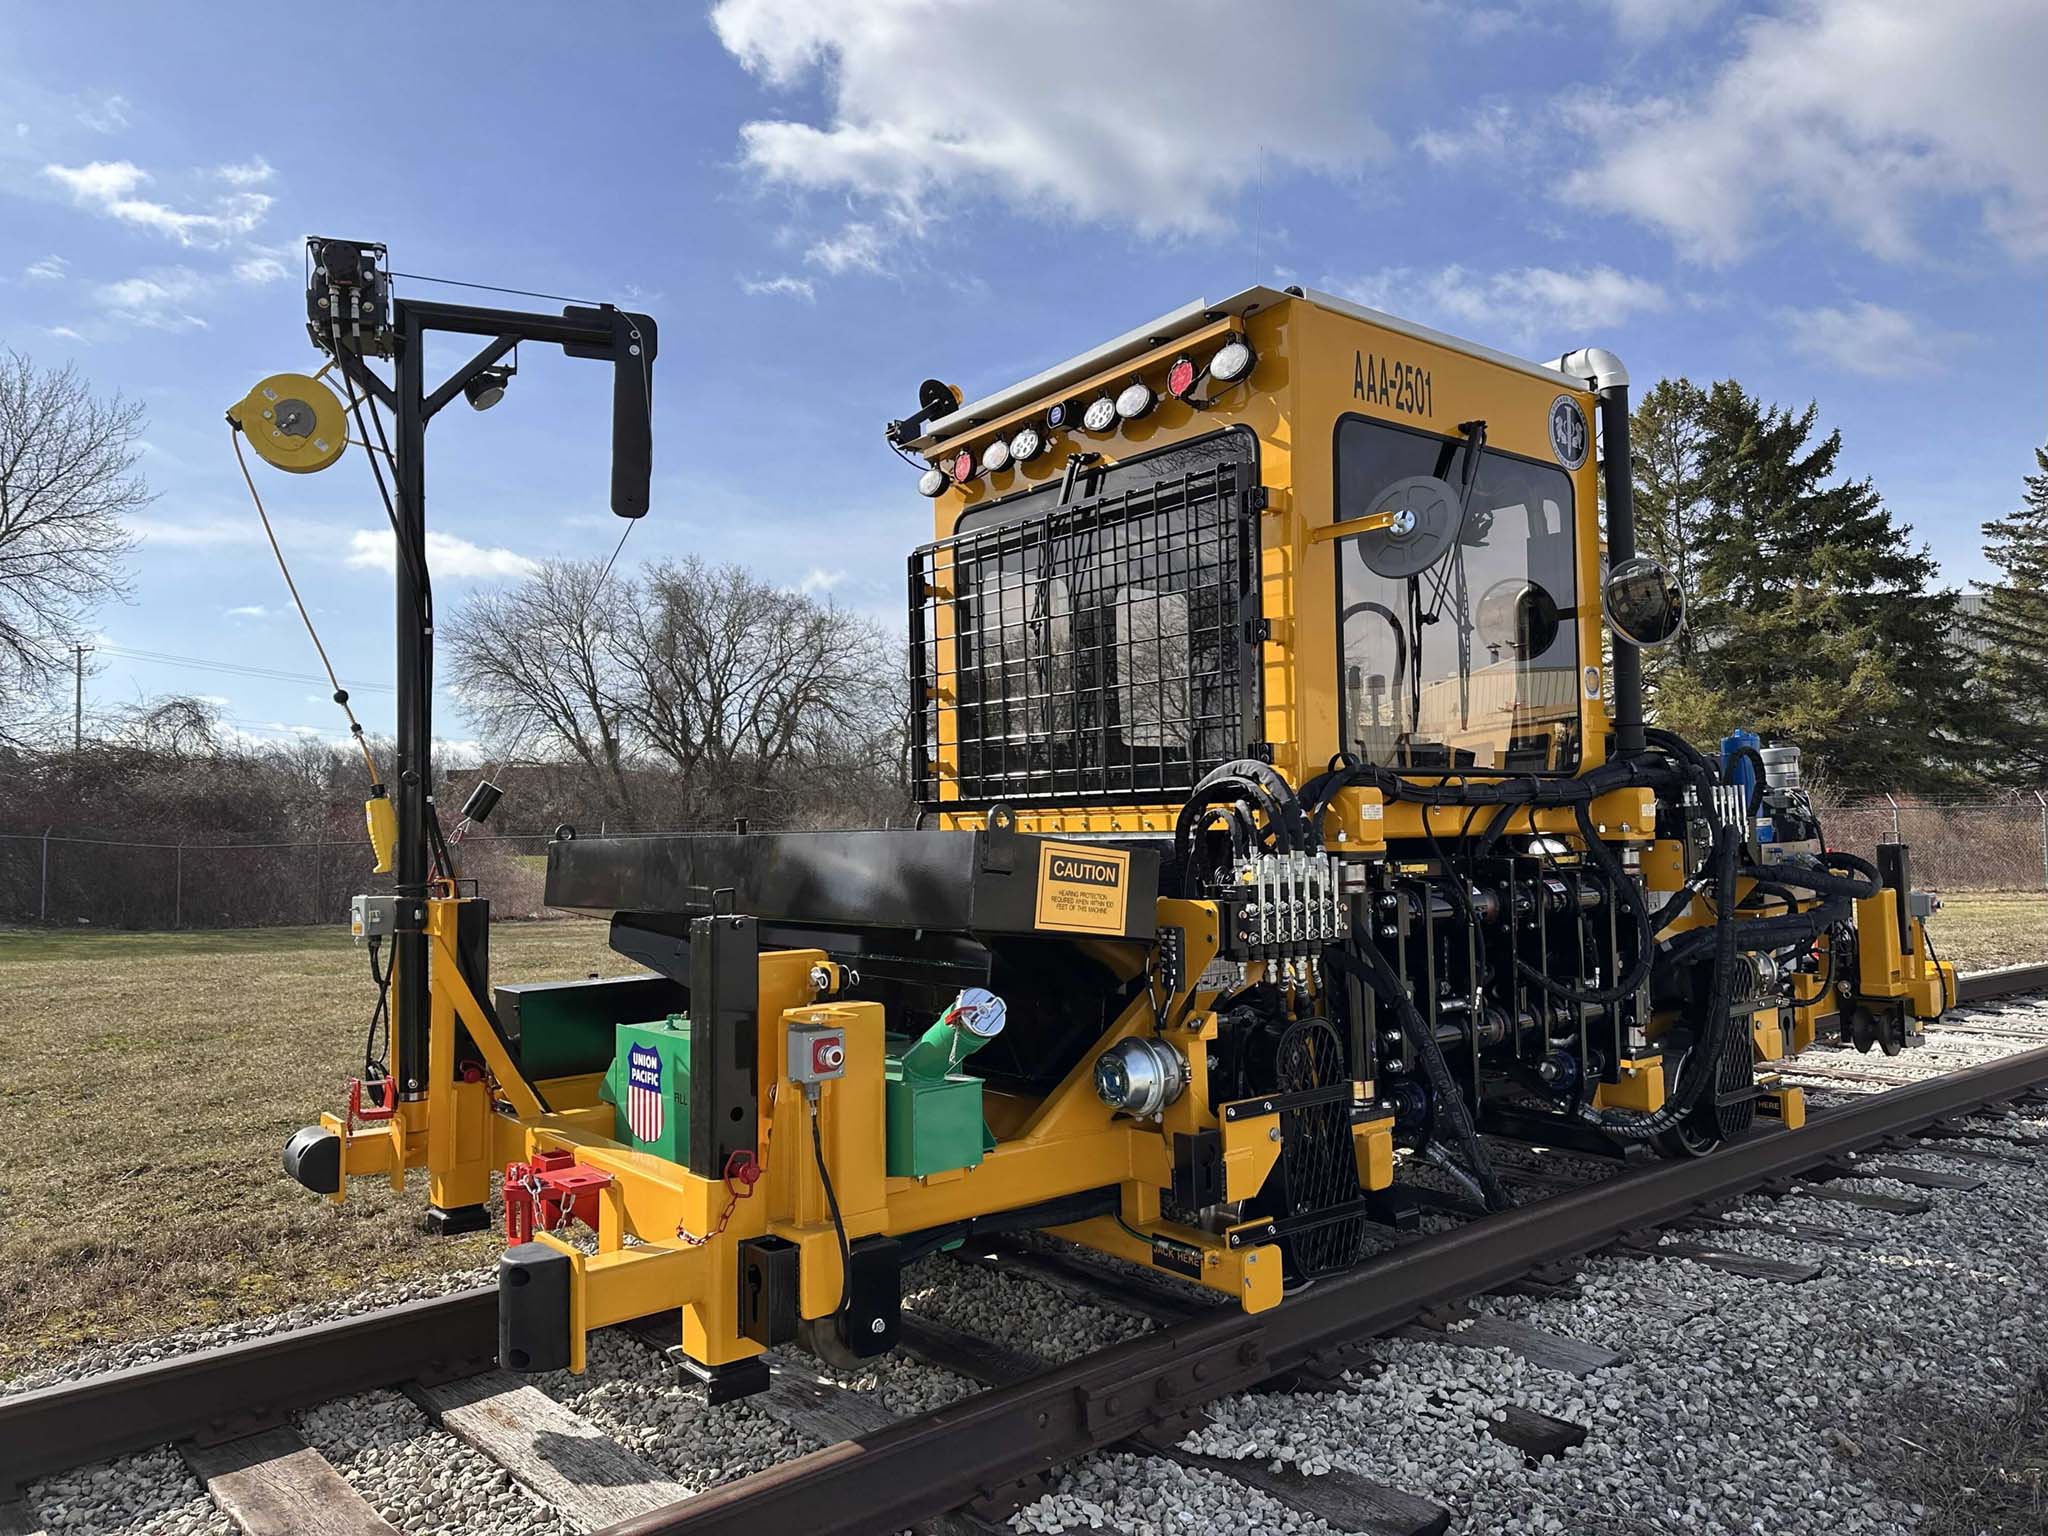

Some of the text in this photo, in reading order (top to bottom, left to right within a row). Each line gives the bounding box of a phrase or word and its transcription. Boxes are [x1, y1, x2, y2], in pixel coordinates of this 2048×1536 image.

[1353, 350, 1432, 418] AAA-2501
[1054, 860, 1116, 882] CAUTION
[1051, 896, 1074, 904] REQUIRED
[1080, 891, 1107, 900] PROTECTION
[633, 1052, 657, 1069] UNION
[631, 1068, 659, 1087] PACIFIC
[674, 1092, 688, 1106] FILL
[1153, 1246, 1175, 1259] JACK
